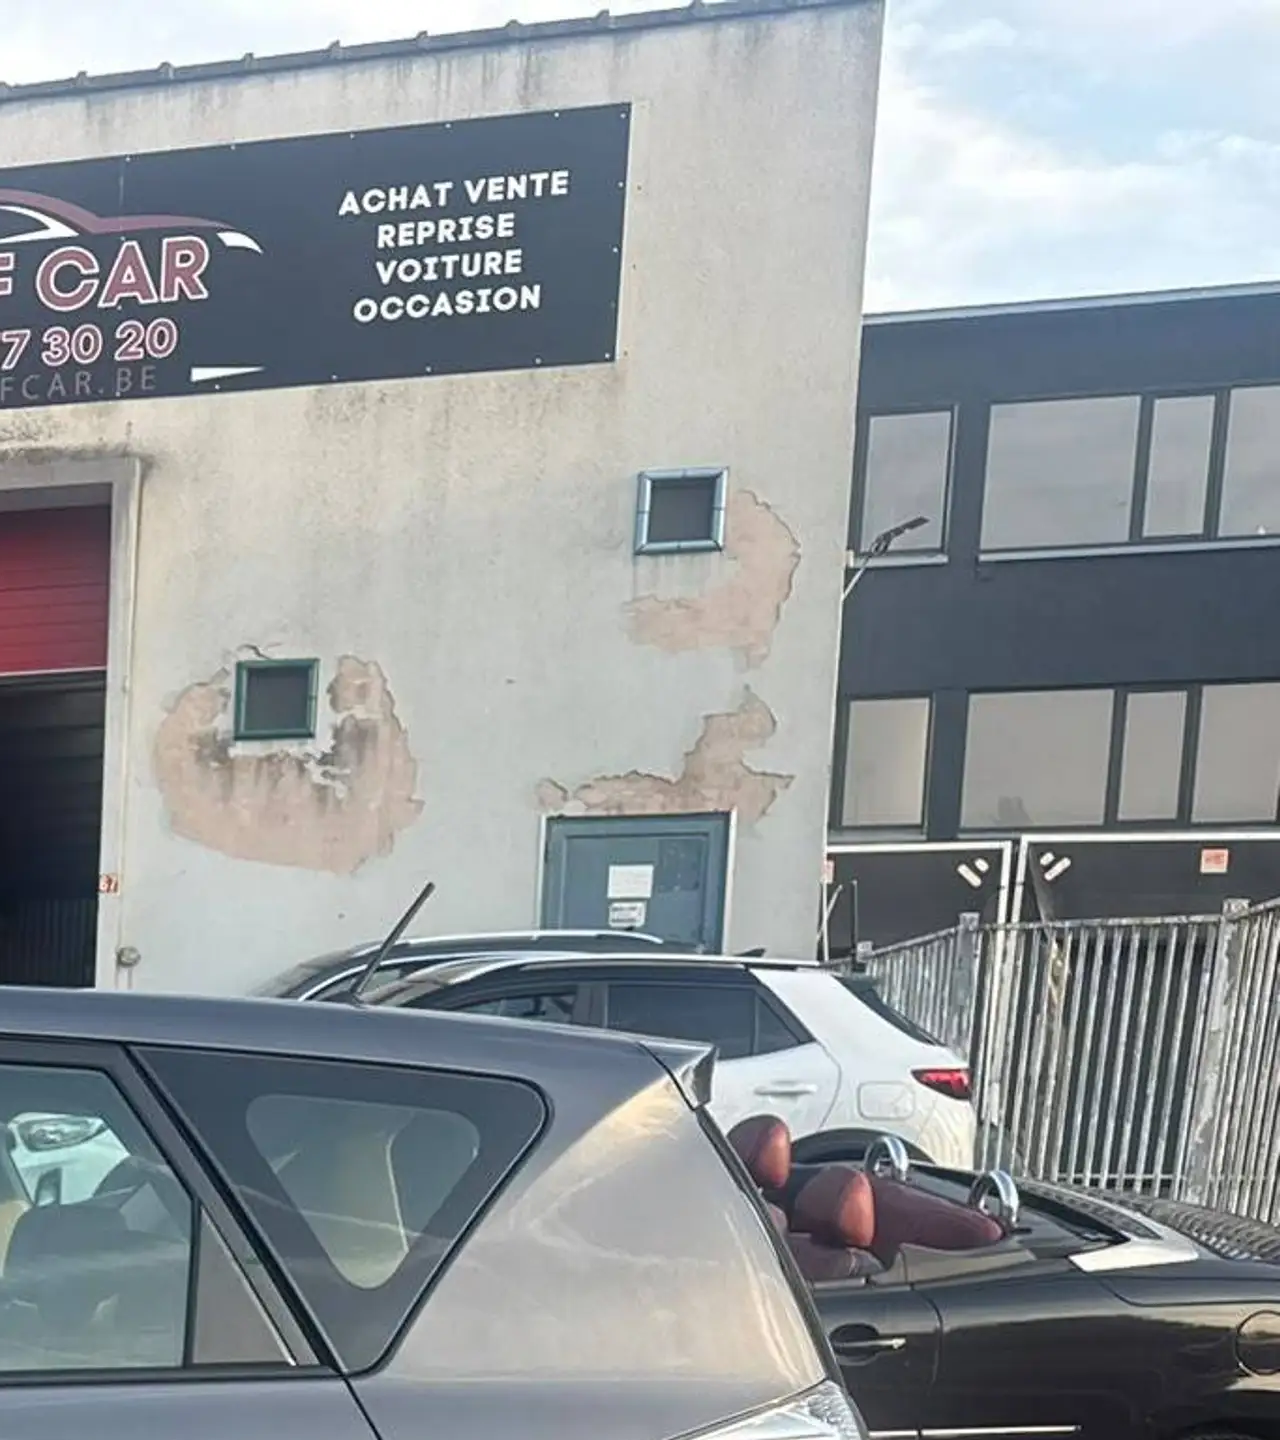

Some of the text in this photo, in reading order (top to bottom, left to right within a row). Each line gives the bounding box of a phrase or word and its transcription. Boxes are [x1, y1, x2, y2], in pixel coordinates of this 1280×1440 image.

[339, 170, 570, 216] ACHAT VENTE
[376, 213, 515, 249] REPRISE
[36, 235, 210, 312] CAR
[375, 249, 523, 285] VOITURE
[353, 285, 541, 323] OCCASION
[41, 326, 104, 366] 30
[114, 318, 179, 362] 20
